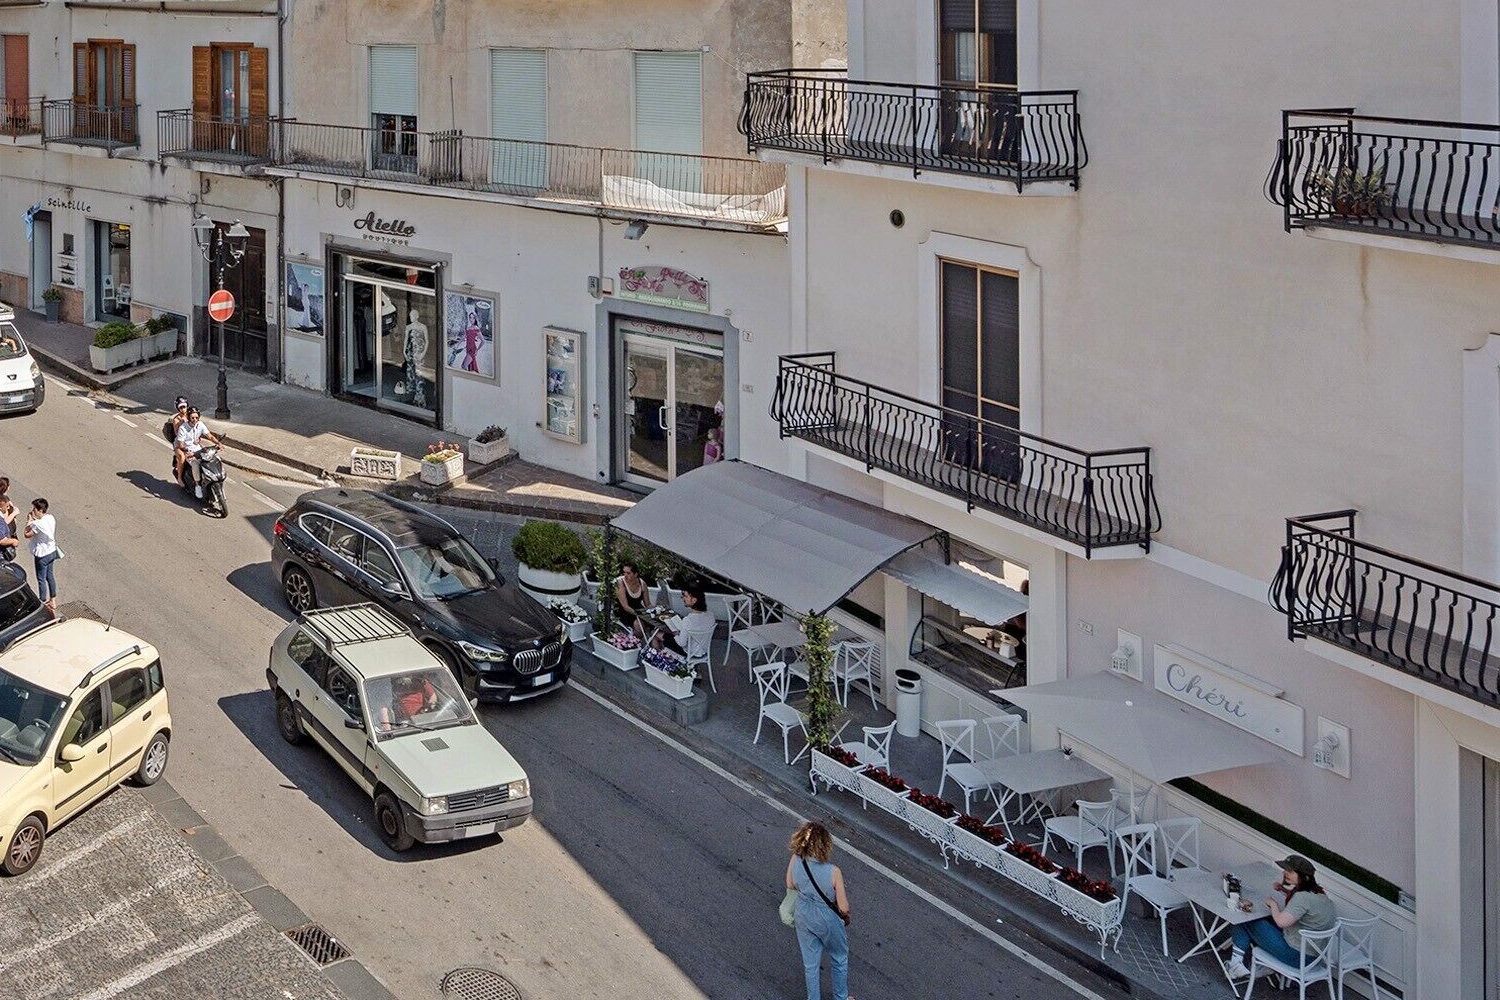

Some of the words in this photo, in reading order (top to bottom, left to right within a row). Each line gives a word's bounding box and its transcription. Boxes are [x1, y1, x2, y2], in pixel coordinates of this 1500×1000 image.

[354, 211, 416, 237] Aiello
[362, 233, 410, 247] BOUTIQUE
[1166, 663, 1247, 718] Chéri
